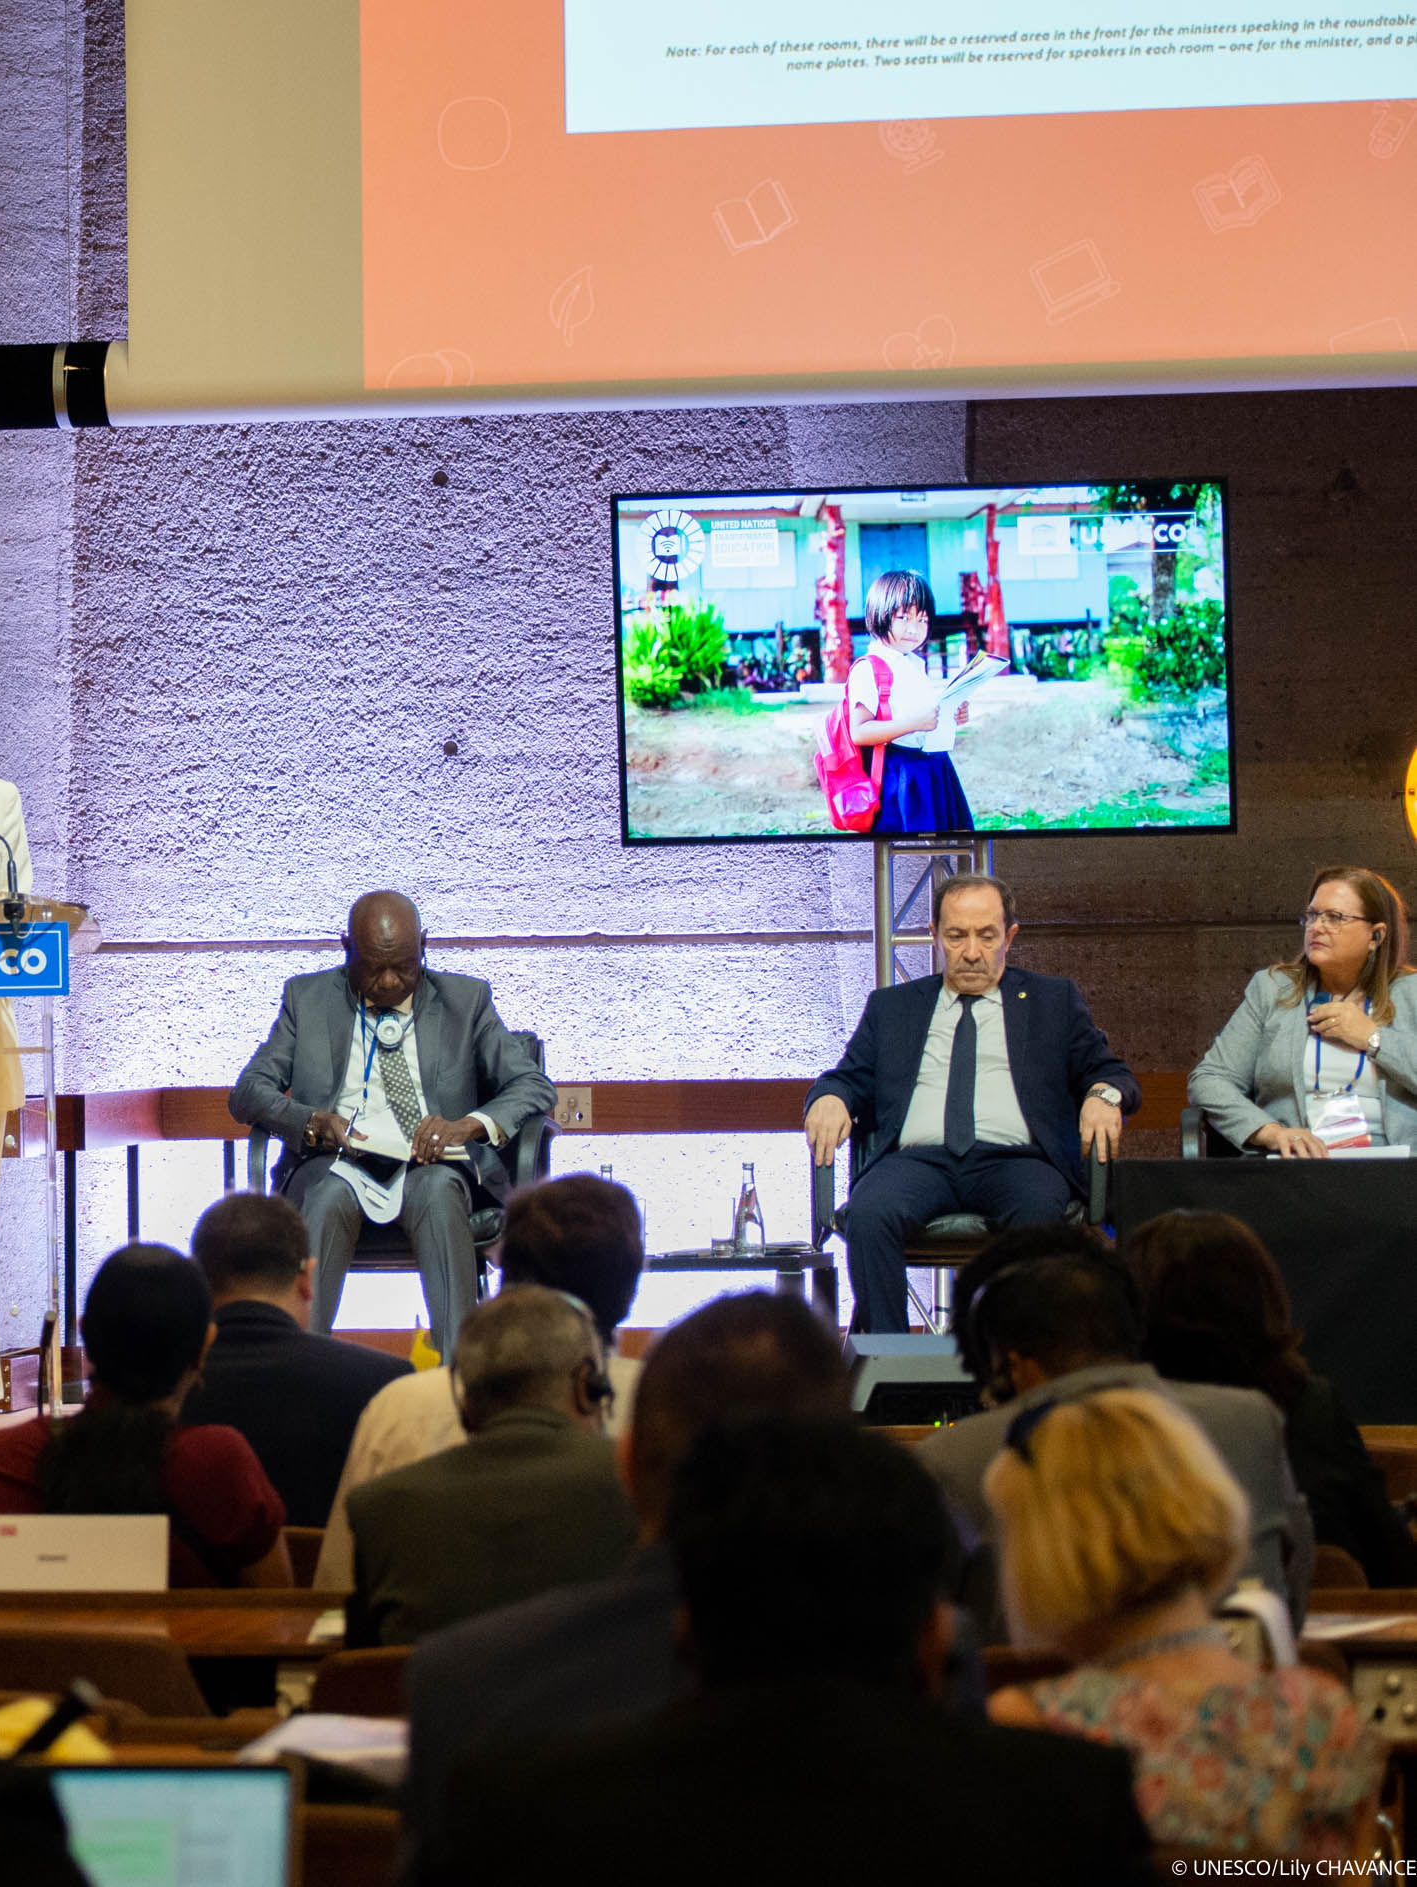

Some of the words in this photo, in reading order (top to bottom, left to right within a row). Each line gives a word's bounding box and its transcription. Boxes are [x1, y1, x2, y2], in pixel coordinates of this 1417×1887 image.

[666, 46, 701, 57] Note:
[705, 44, 726, 55] For
[729, 42, 759, 54] each
[763, 40, 777, 55] of
[780, 40, 814, 52] these
[818, 40, 862, 50] rooms,
[866, 36, 900, 48] there
[904, 36, 927, 46] will
[931, 34, 946, 46] be
[949, 35, 957, 45] a
[961, 30, 1018, 44] reserved
[1020, 32, 1050, 41] area
[1054, 30, 1066, 40] in
[1070, 27, 1091, 39] the
[1094, 26, 1127, 40] front
[1129, 25, 1150, 39] for
[1153, 24, 1174, 36] the
[1177, 23, 1237, 34] ministers
[1241, 19, 1299, 34] speaking
[1304, 19, 1315, 30] in
[1320, 17, 1340, 29] the
[1344, 14, 1416, 27] roundtable
[787, 60, 822, 70] name
[827, 57, 868, 70] plates.
[875, 55, 901, 66] Two
[905, 55, 938, 65] seats
[942, 51, 966, 63] will
[968, 52, 984, 62] be
[987, 48, 1044, 61] reserved
[1046, 48, 1065, 61] for
[1069, 45, 1126, 60] speakers
[1129, 45, 1142, 56] in
[1146, 43, 1176, 55] each
[1180, 44, 1214, 53] room
[1230, 42, 1254, 52] one
[1256, 39, 1276, 53] for
[1280, 38, 1301, 49] the
[1305, 37, 1362, 48] minister,
[1367, 33, 1392, 45] and
[1395, 35, 1403, 45] a
[710, 519, 740, 530] UNITED
[741, 518, 777, 529] NATIONS
[1080, 524, 1187, 545] uco
